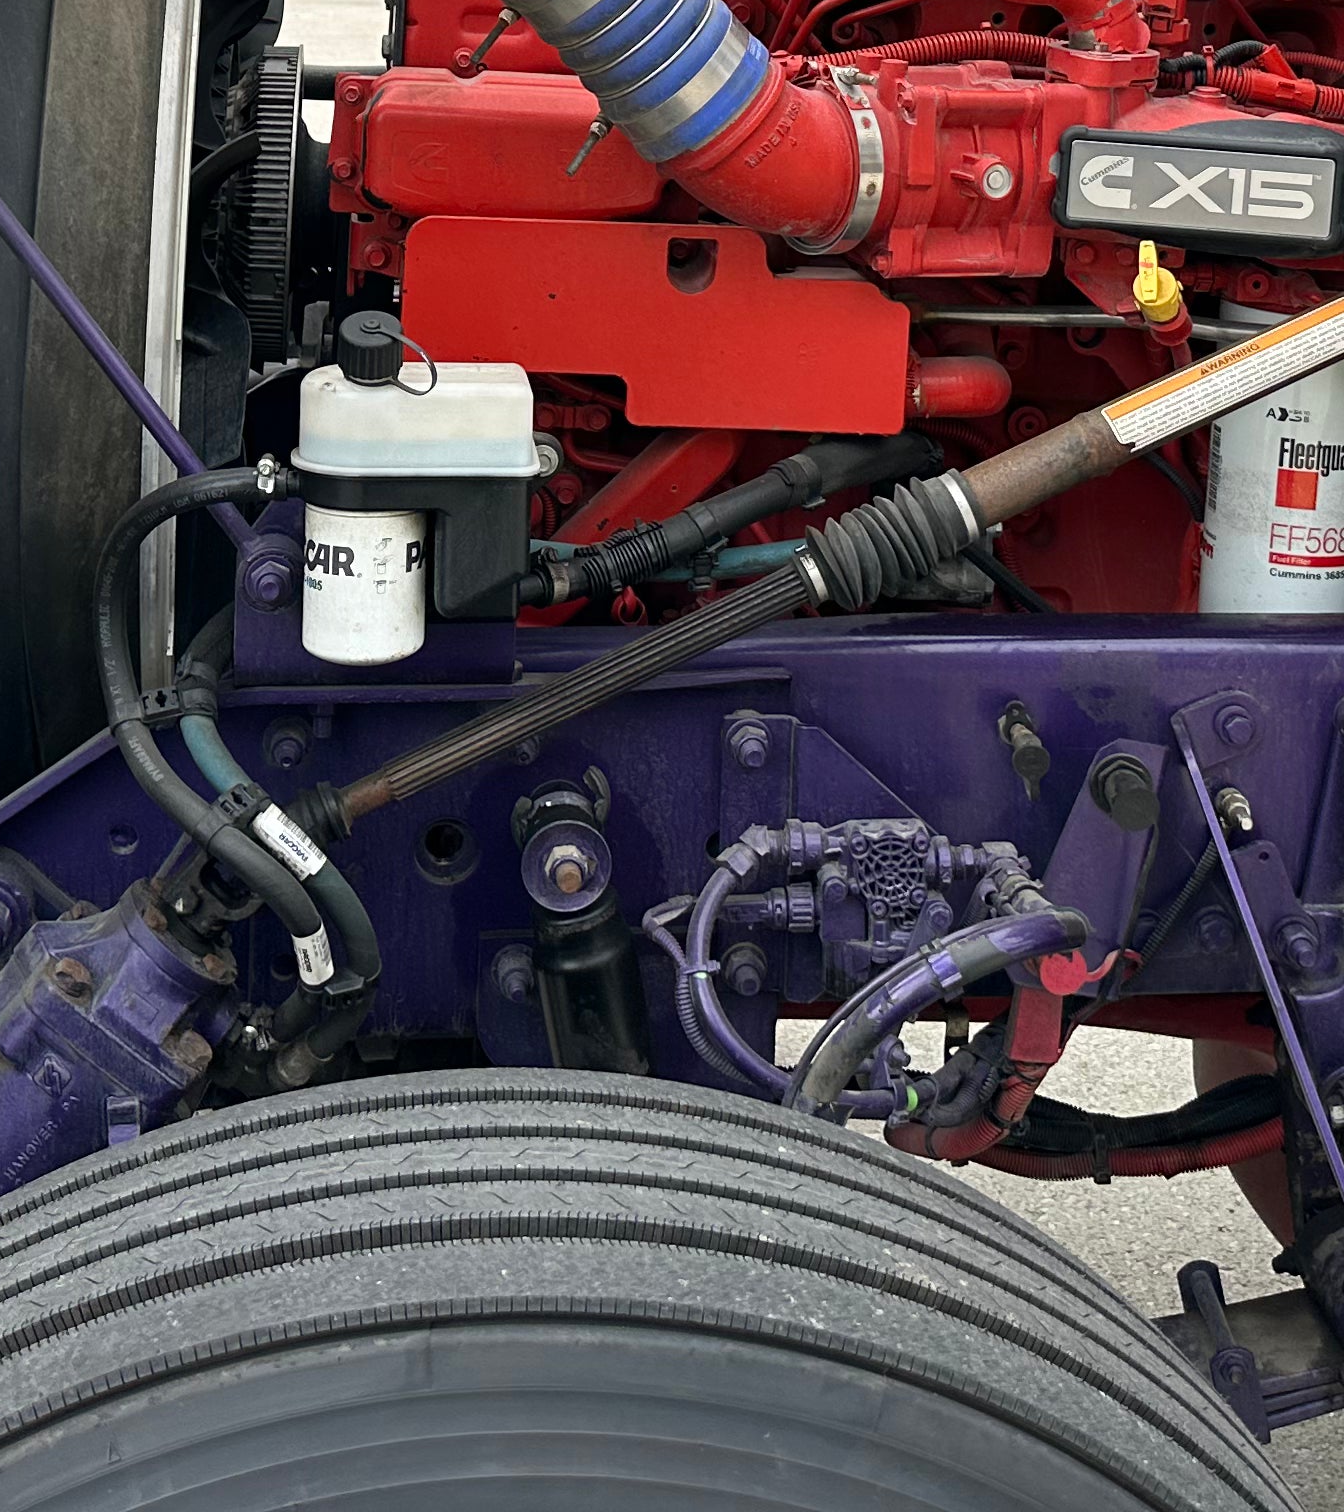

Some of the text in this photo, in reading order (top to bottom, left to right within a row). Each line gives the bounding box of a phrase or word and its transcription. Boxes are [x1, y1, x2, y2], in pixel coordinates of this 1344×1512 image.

[1080, 155, 1130, 187] Cummins
[1148, 161, 1315, 220] X15
[1207, 341, 1260, 371] WARNING
[1269, 568, 1321, 580] Cummins
[1272, 556, 1311, 565] Fuel Filter
